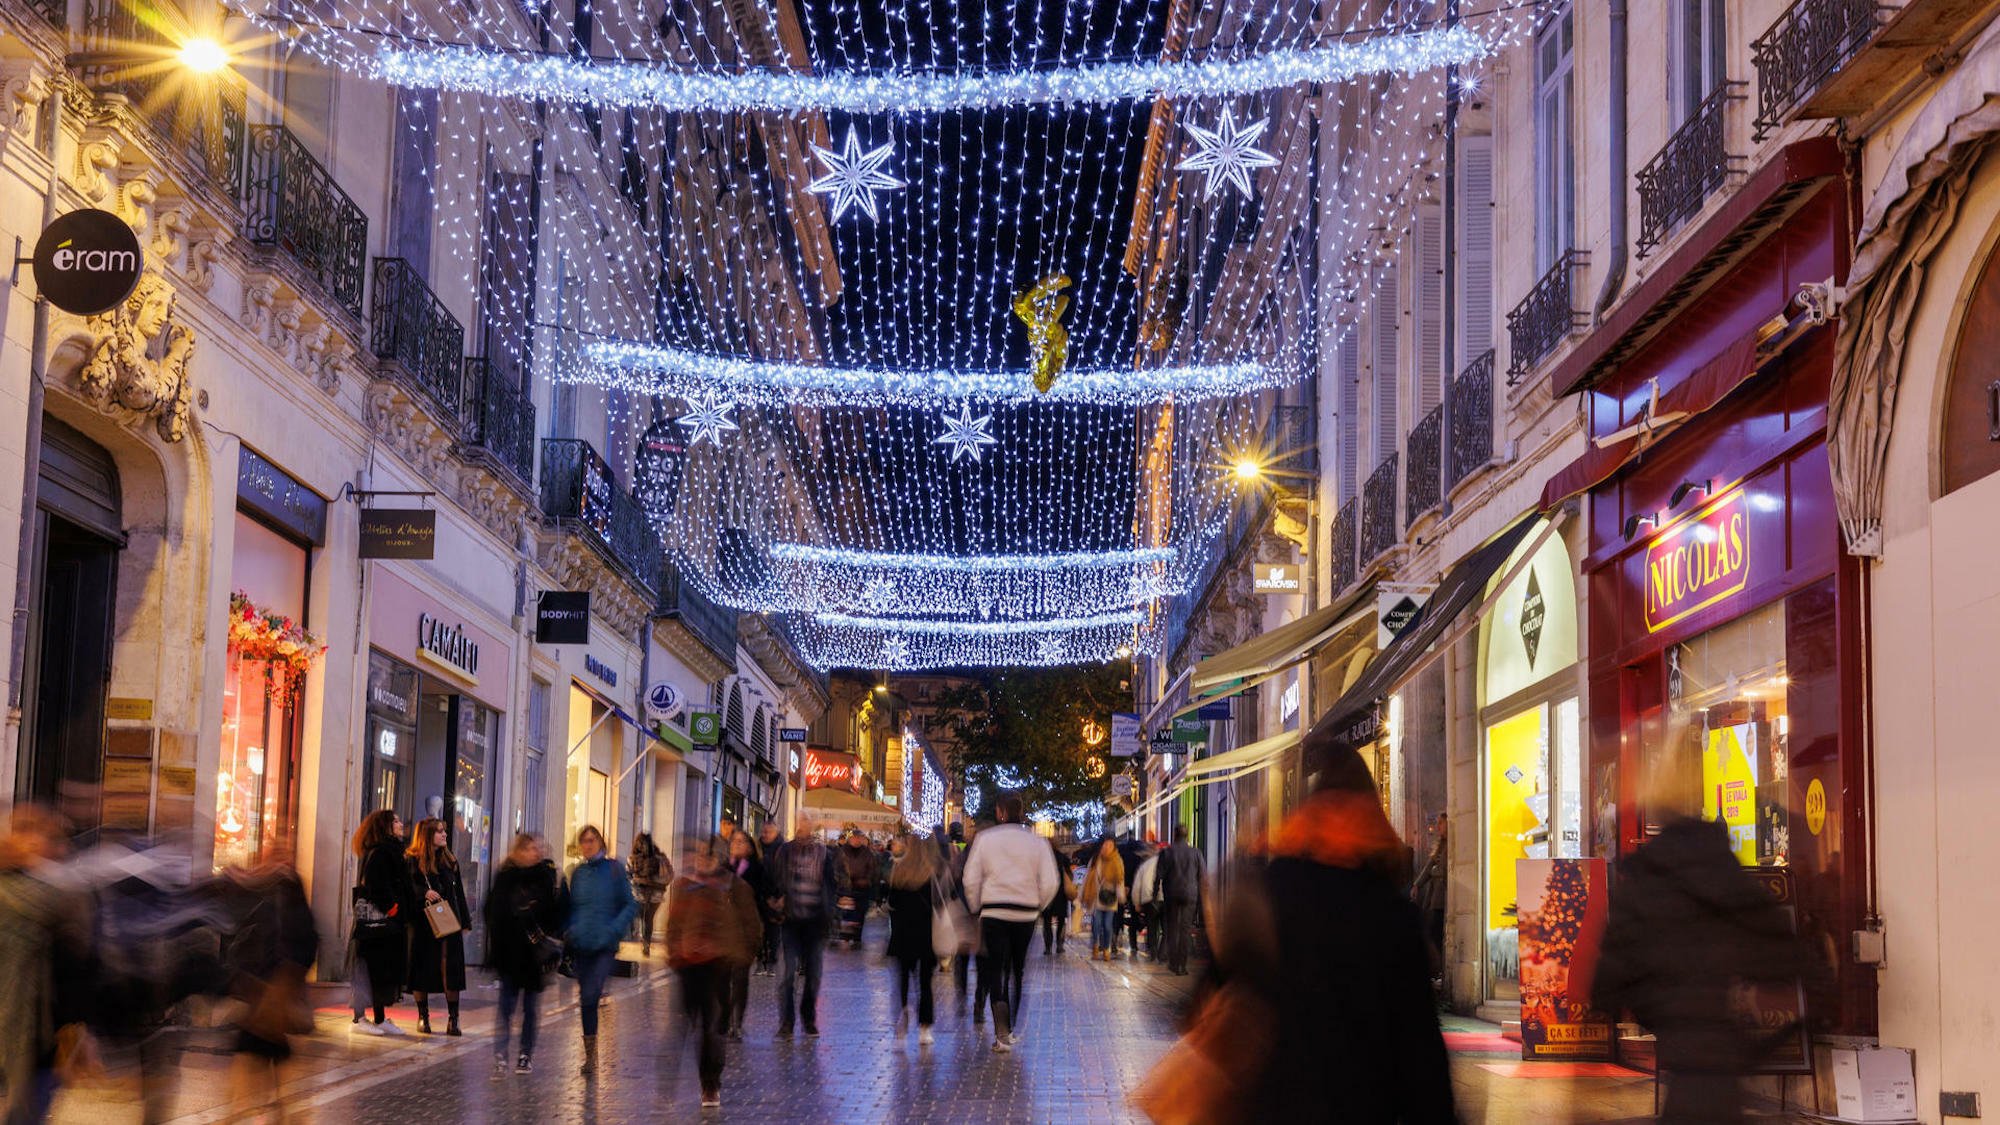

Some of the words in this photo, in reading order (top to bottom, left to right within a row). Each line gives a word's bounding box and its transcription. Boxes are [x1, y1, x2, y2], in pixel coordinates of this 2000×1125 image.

[53, 239, 136, 272] éram
[1650, 512, 1743, 614] NICOLAS
[781, 730, 805, 740] VANS
